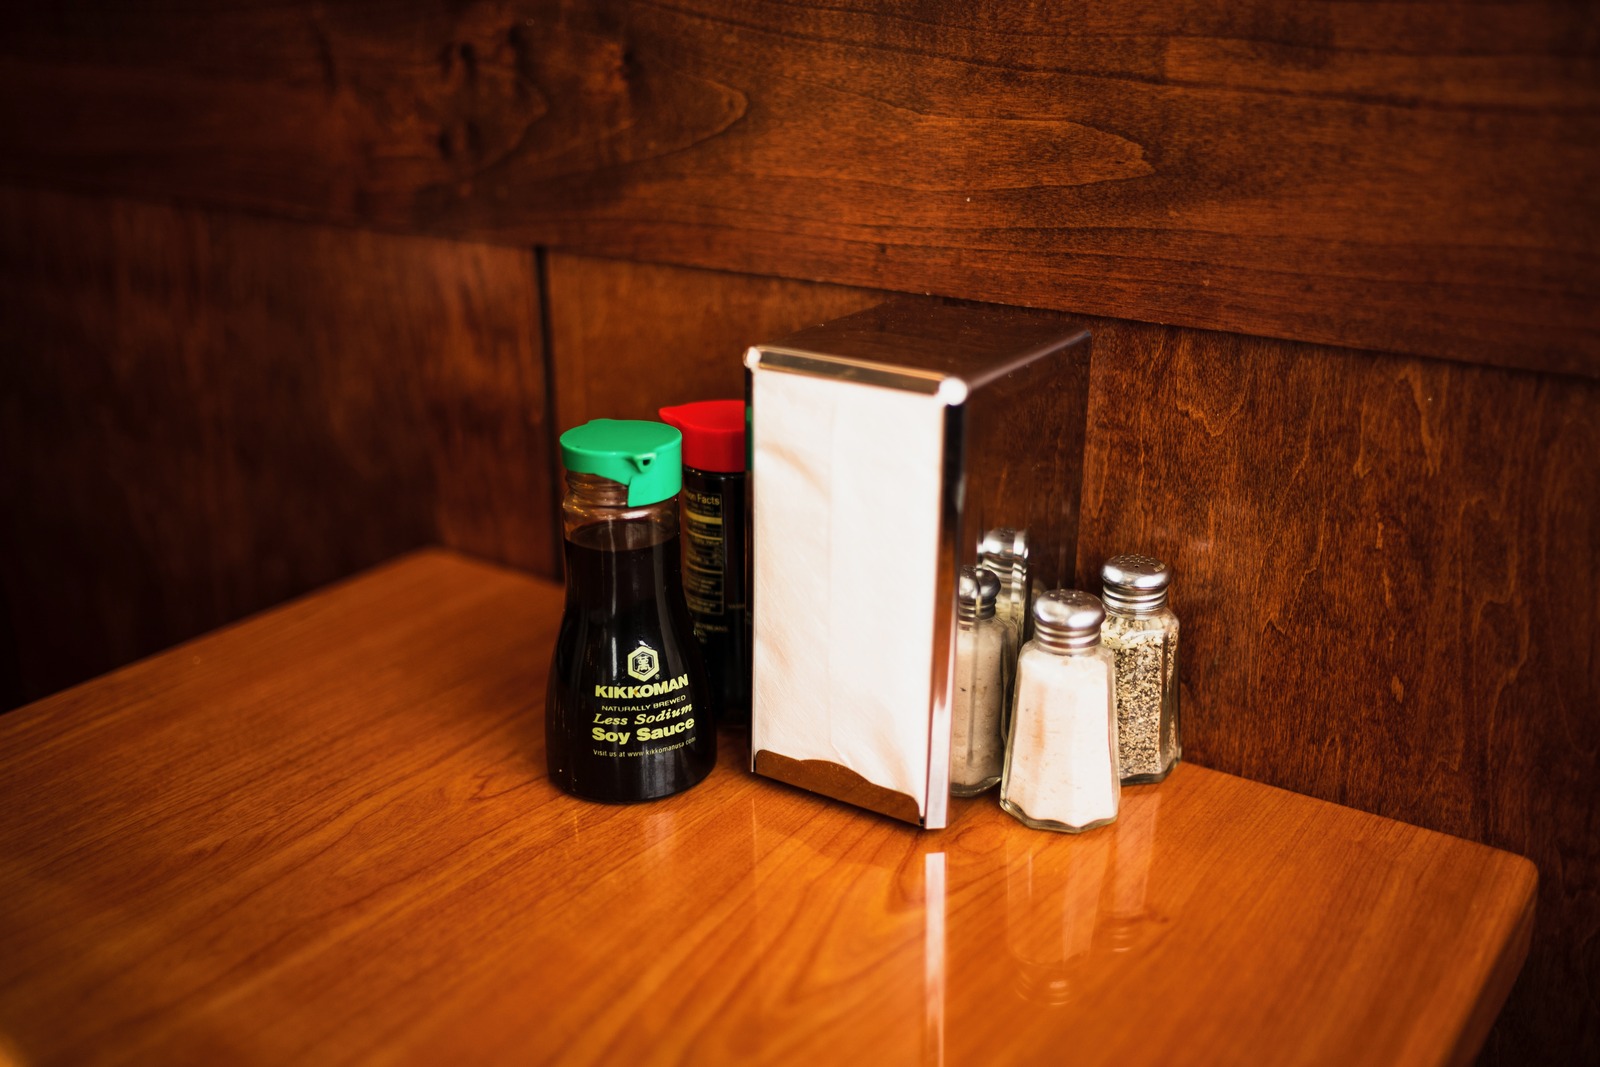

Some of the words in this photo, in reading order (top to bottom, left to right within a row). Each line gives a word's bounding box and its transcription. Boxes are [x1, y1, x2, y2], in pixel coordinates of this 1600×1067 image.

[697, 494, 720, 505] Facts
[595, 674, 689, 698] KIKKOMAN
[602, 704, 650, 712] NATURALLY
[653, 695, 686, 709] BREWED
[593, 713, 628, 725] Less
[634, 704, 692, 725] Sodium
[592, 727, 630, 745] Soy
[637, 718, 694, 741] Sauce
[627, 736, 696, 757] wwwkikkomanusacom
